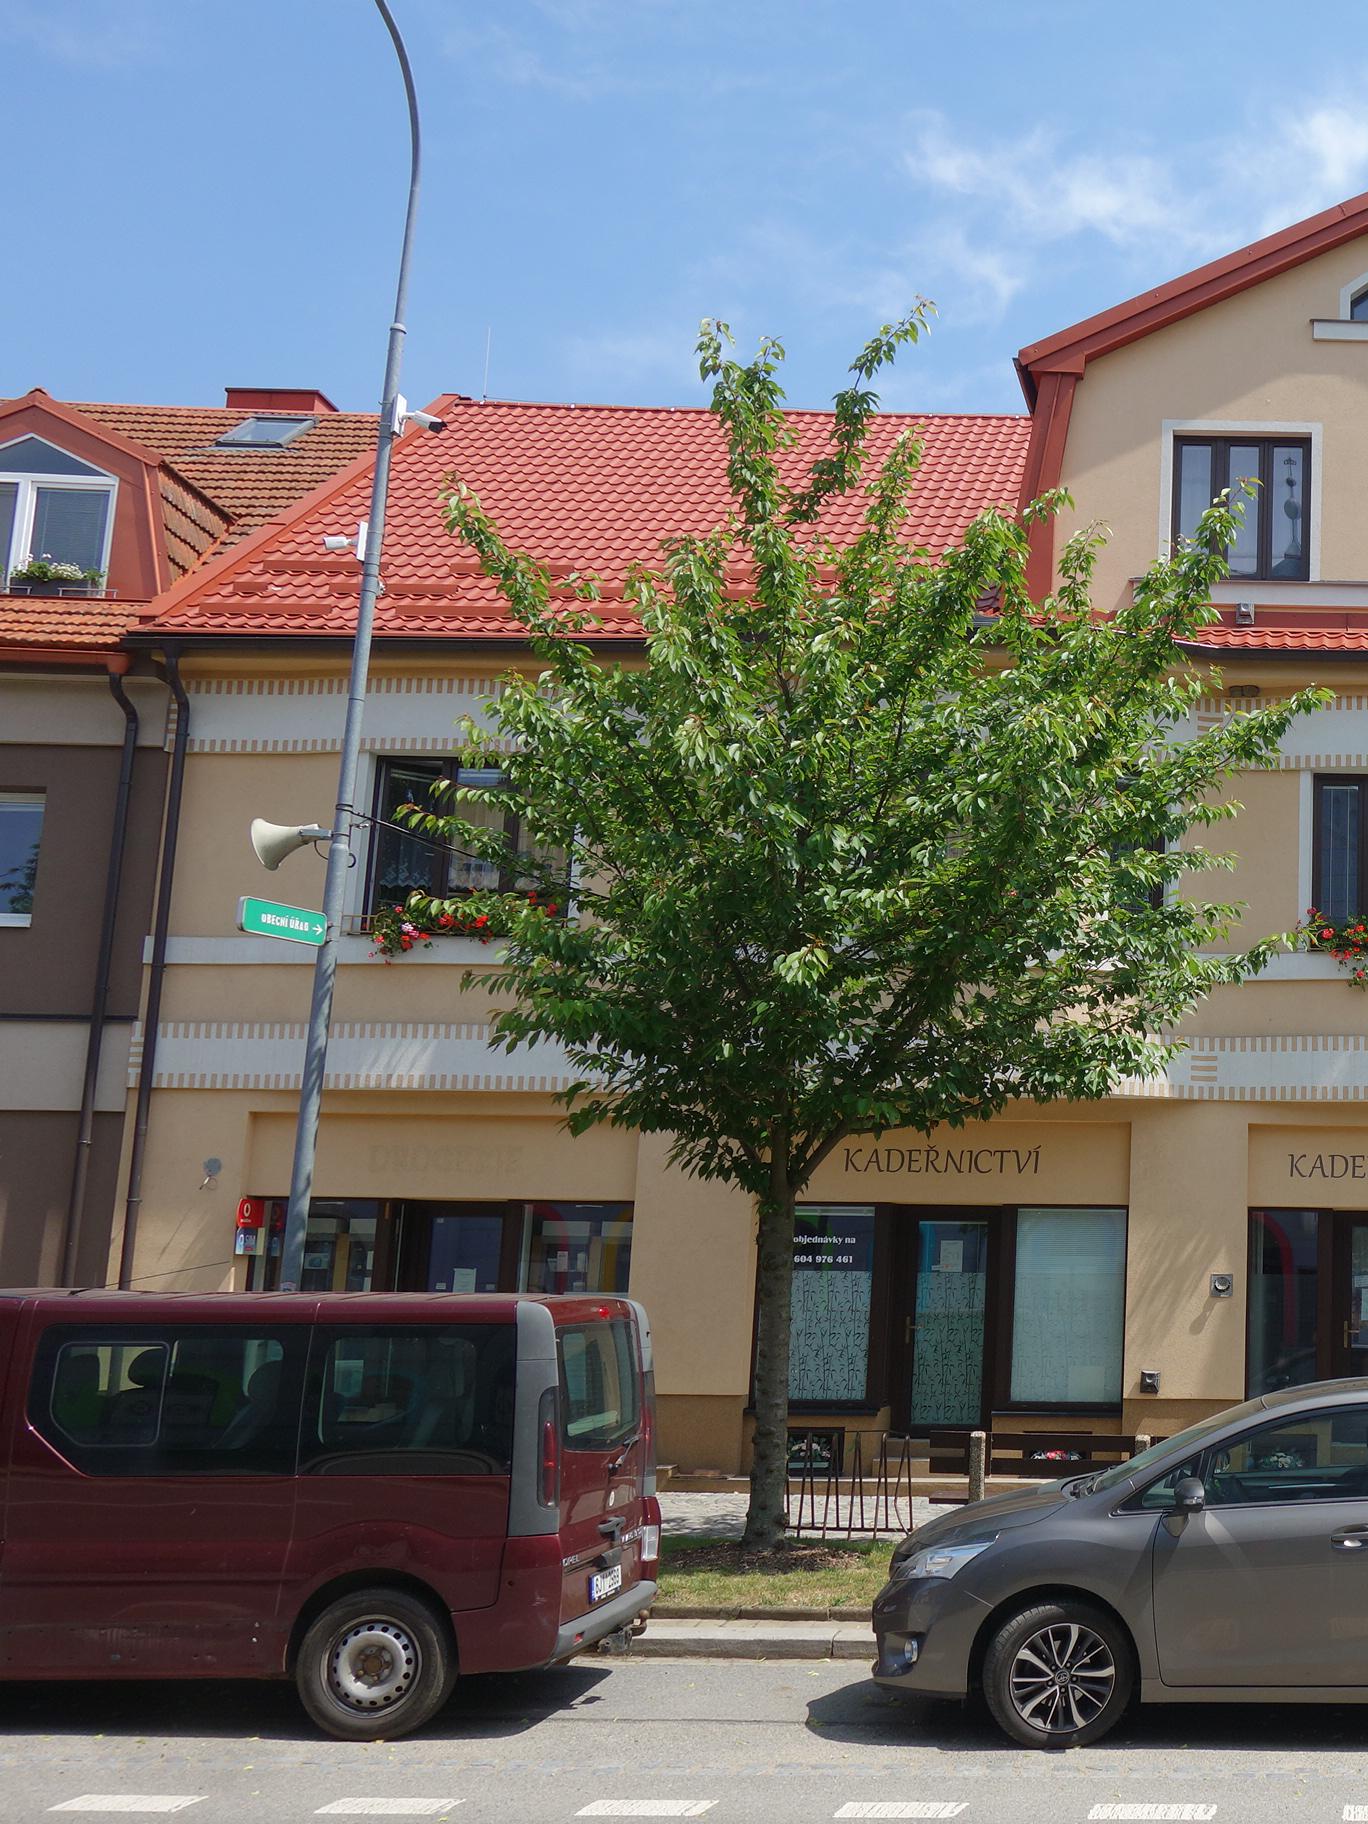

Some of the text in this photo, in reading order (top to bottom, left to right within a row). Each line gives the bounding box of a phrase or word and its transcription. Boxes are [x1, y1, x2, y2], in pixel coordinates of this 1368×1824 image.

[261, 913, 309, 931] OBECNÍ ÚŘAD
[844, 1144, 1042, 1174] KADEŘNICTVÍ
[793, 1235, 843, 1245] objednávky
[793, 1255, 853, 1263] 604 976 461
